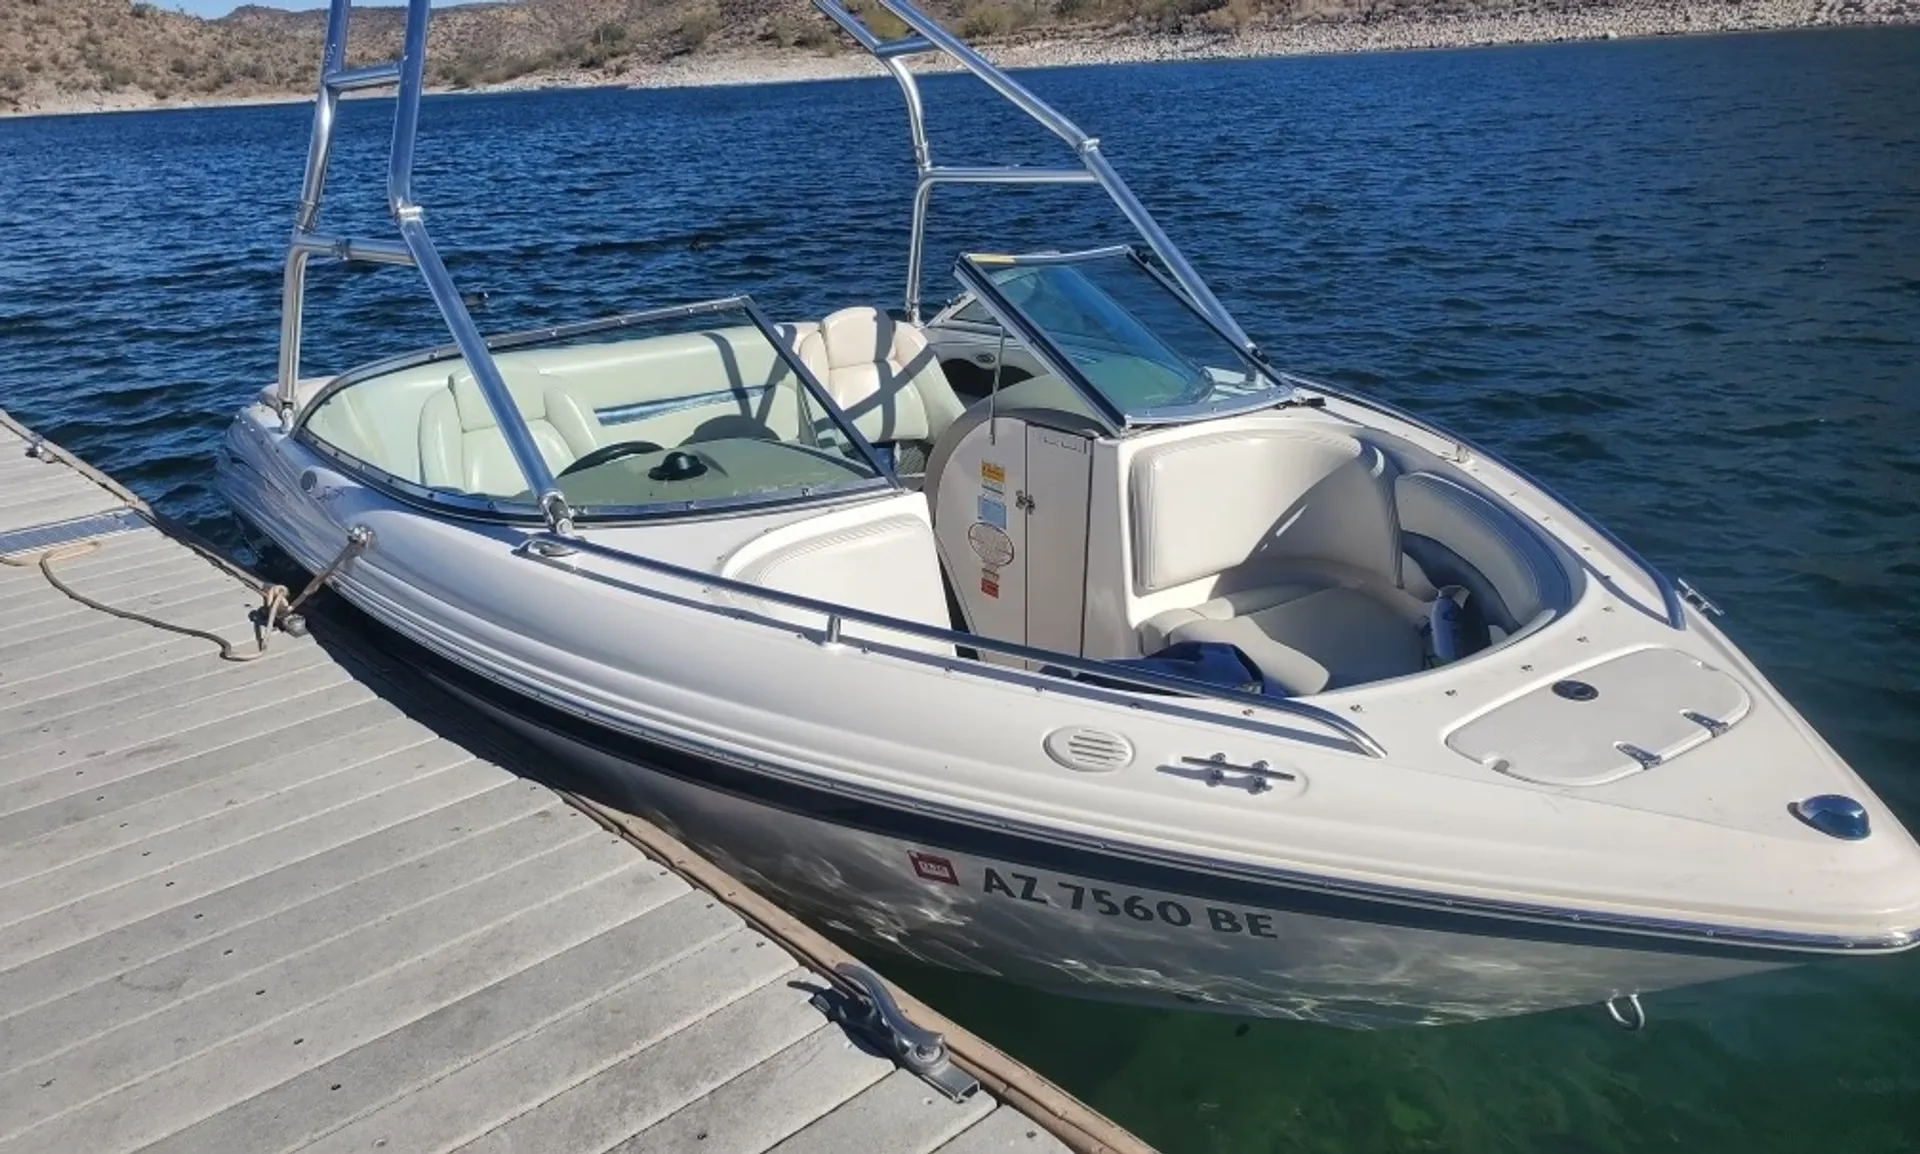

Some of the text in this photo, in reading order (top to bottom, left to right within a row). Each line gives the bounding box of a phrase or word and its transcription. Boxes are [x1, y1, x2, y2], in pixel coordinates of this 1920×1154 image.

[983, 867, 1048, 905] AZ
[1057, 881, 1192, 927] 7560
[1207, 906, 1278, 939] BE
